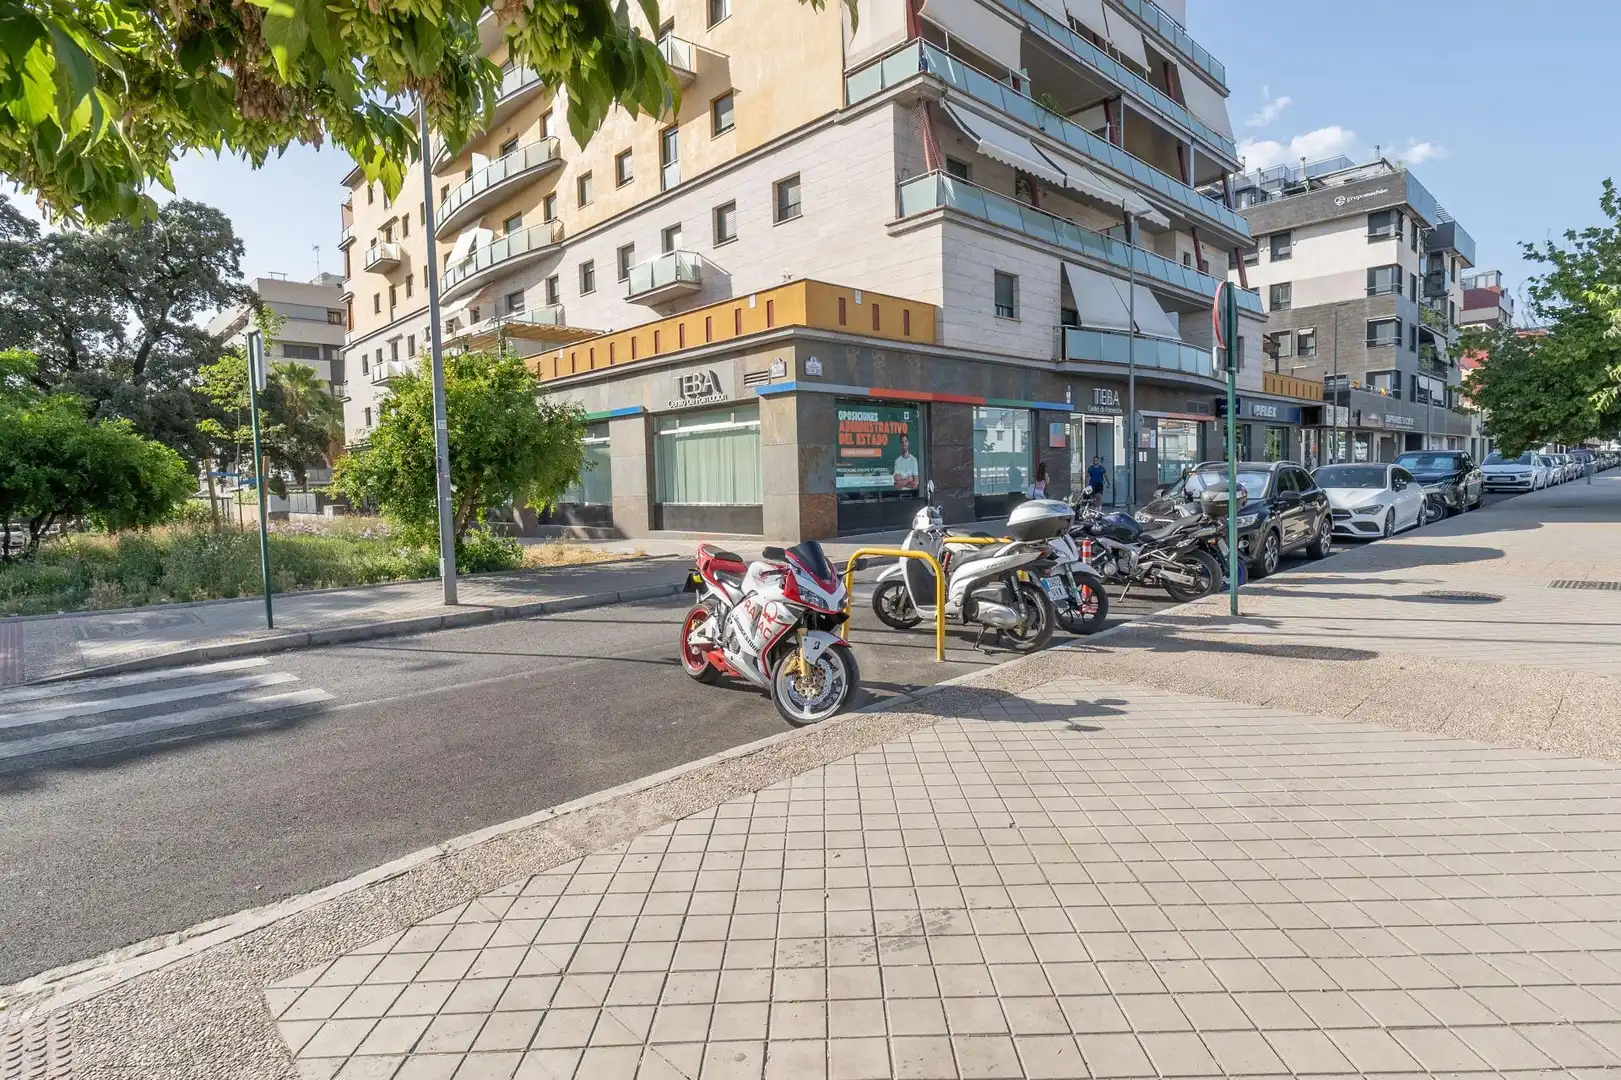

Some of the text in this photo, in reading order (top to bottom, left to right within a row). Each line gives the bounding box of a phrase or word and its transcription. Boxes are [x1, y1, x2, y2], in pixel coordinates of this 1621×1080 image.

[672, 369, 717, 397] TEBA
[1092, 388, 1120, 406] TEBA
[838, 410, 879, 422] OPOSICIONES
[838, 420, 908, 434] ADMINISTRATIVO
[838, 432, 888, 446] DEL ESTADO
